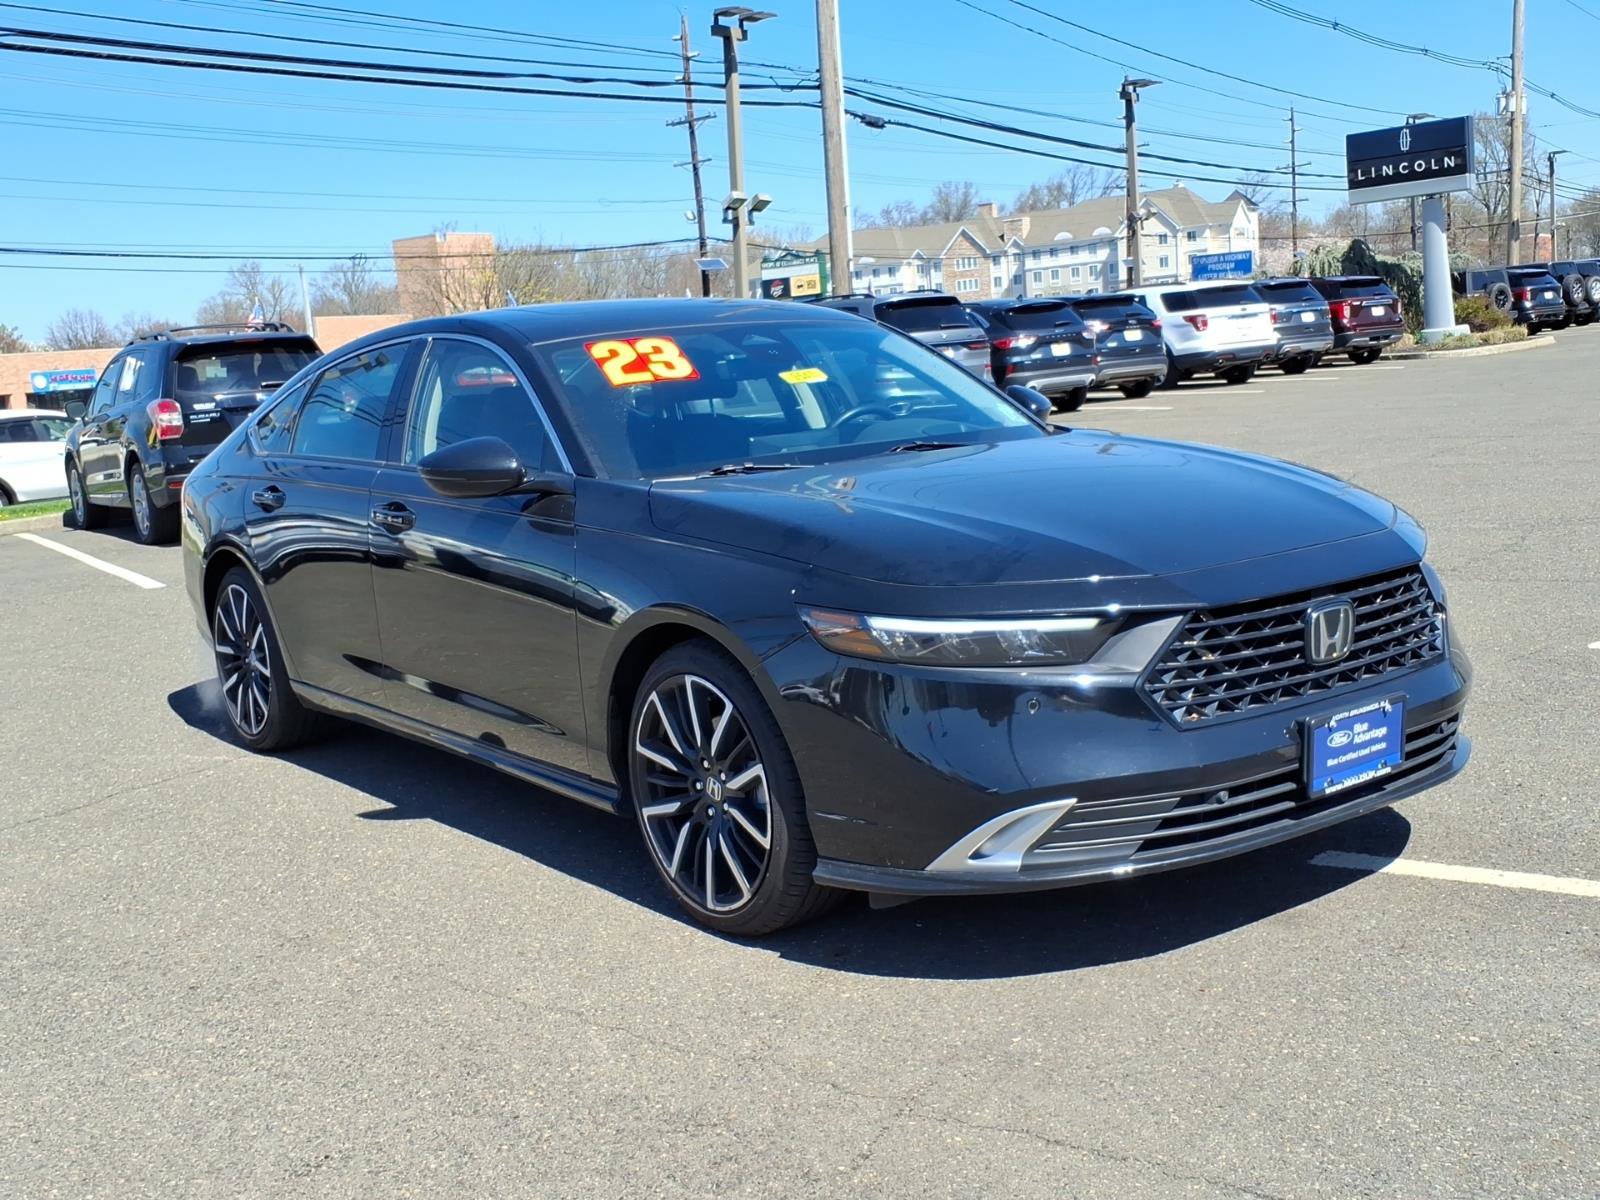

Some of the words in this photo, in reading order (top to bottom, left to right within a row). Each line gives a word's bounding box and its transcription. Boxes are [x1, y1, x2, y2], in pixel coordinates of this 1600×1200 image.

[1357, 156, 1456, 180] LINCOLN
[1208, 262, 1235, 271] PROGRAM
[590, 337, 695, 388] 23
[1353, 722, 1369, 734] Blue
[1353, 726, 1388, 745] Advantage
